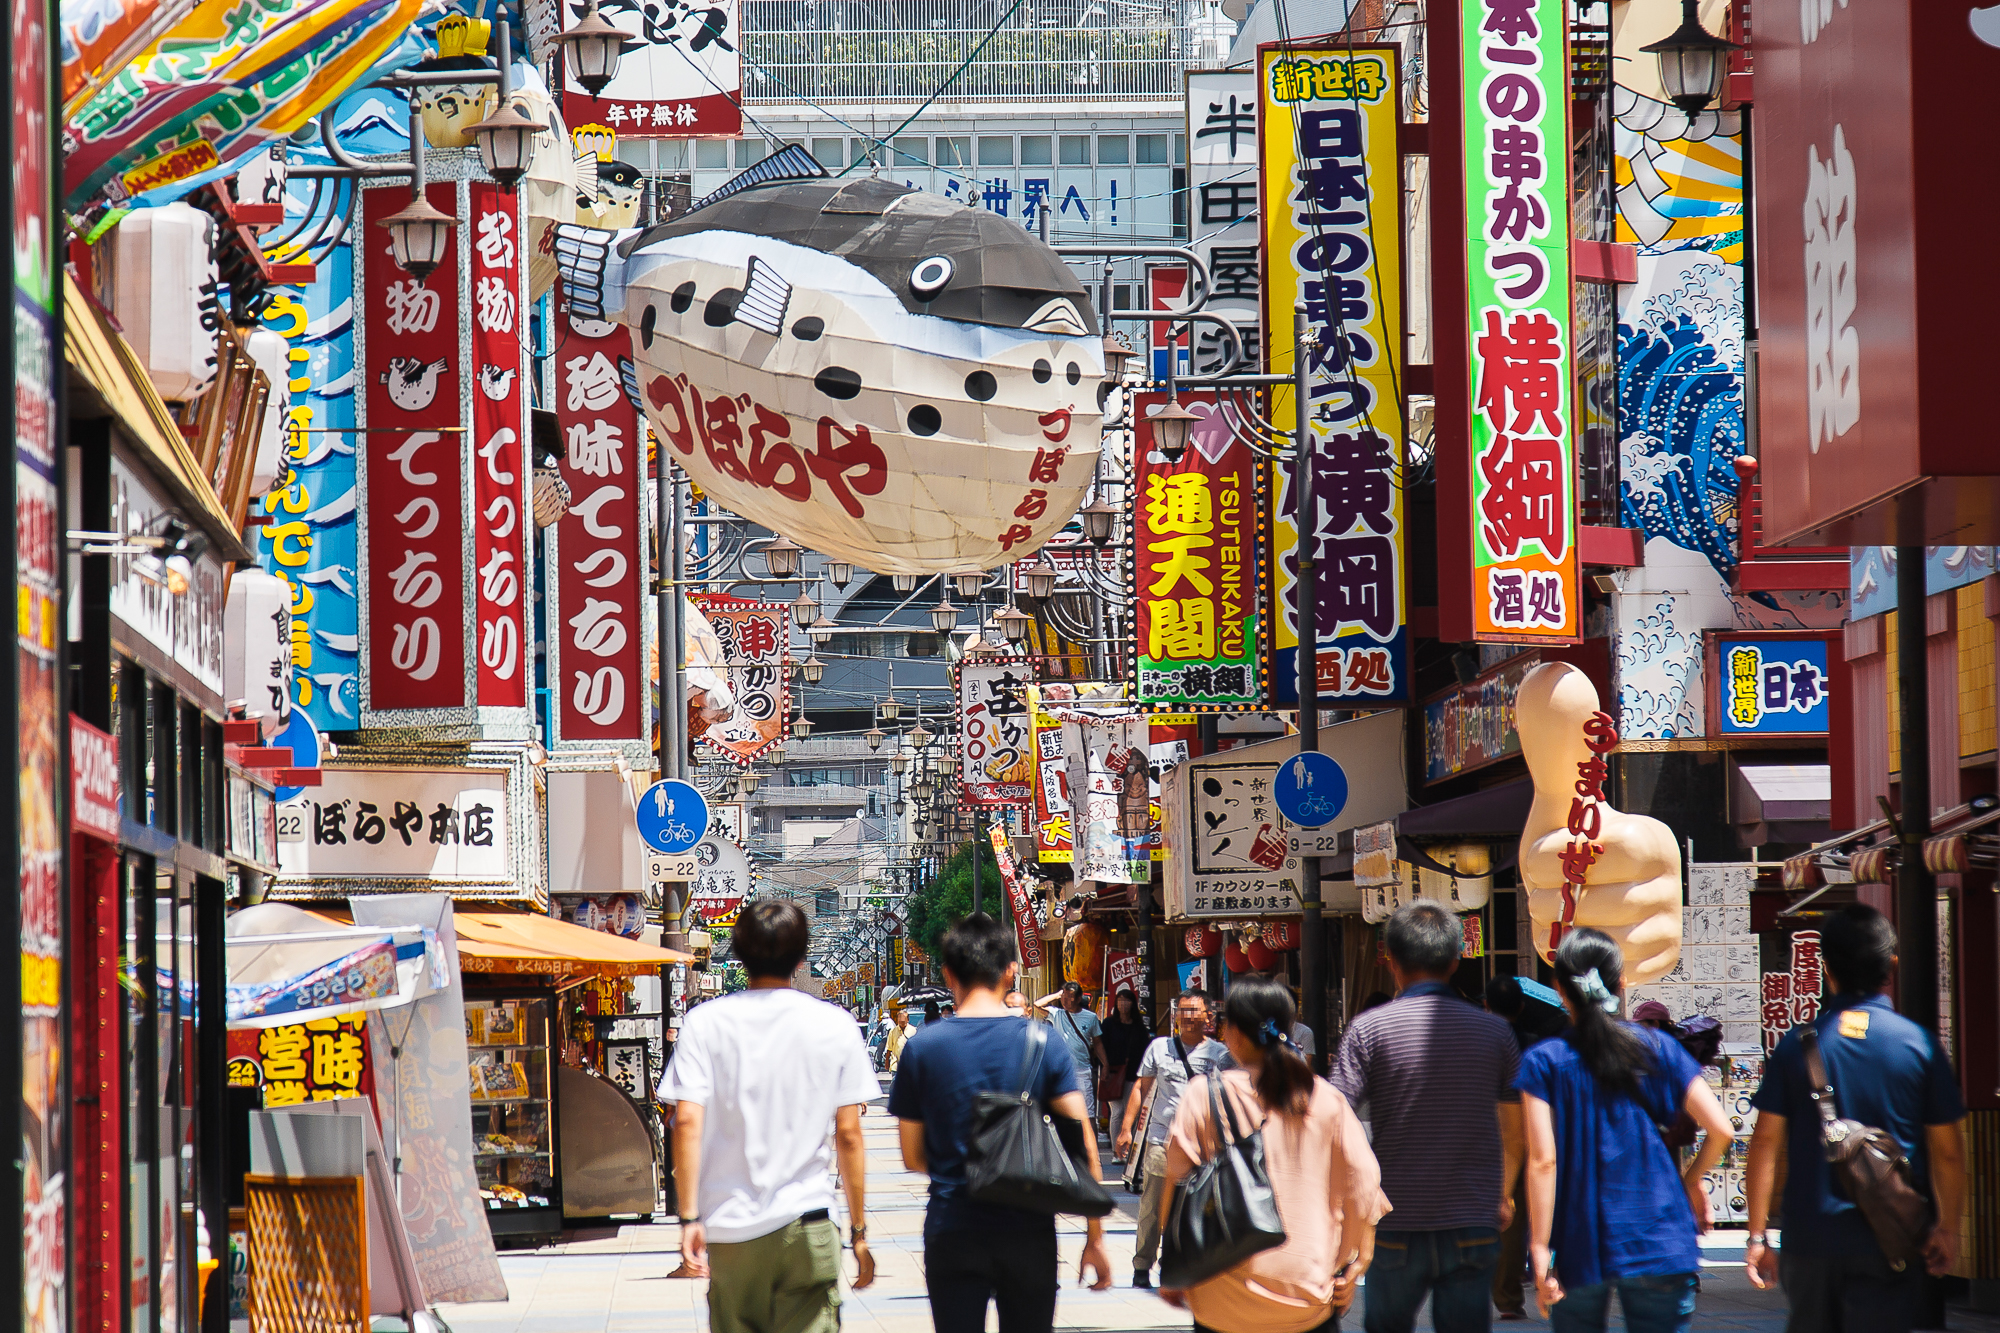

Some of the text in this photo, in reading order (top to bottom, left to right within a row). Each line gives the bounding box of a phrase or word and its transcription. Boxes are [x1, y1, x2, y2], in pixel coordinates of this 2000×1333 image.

[1271, 58, 1388, 102] 新世界
[605, 103, 698, 127] 年中無休
[386, 431, 443, 681] てっちり
[477, 427, 518, 681] てっちり
[564, 351, 628, 726] 珍味てっちり
[1145, 472, 1215, 661] 通天閣
[1219, 470, 1246, 656] TSUTENKAKU
[1493, 573, 1561, 624] 酒処
[737, 616, 778, 720] 串かつ
[1142, 671, 1180, 682] 日本一の
[1142, 683, 1180, 696] 串かつ
[1733, 651, 1758, 723] 新世界
[1249, 777, 1271, 823] 新世界
[1194, 897, 1208, 910] 2F
[1195, 879, 1293, 893] 1F カウンター席
[296, 969, 366, 1007] さらさら
[228, 1061, 256, 1078] 24
